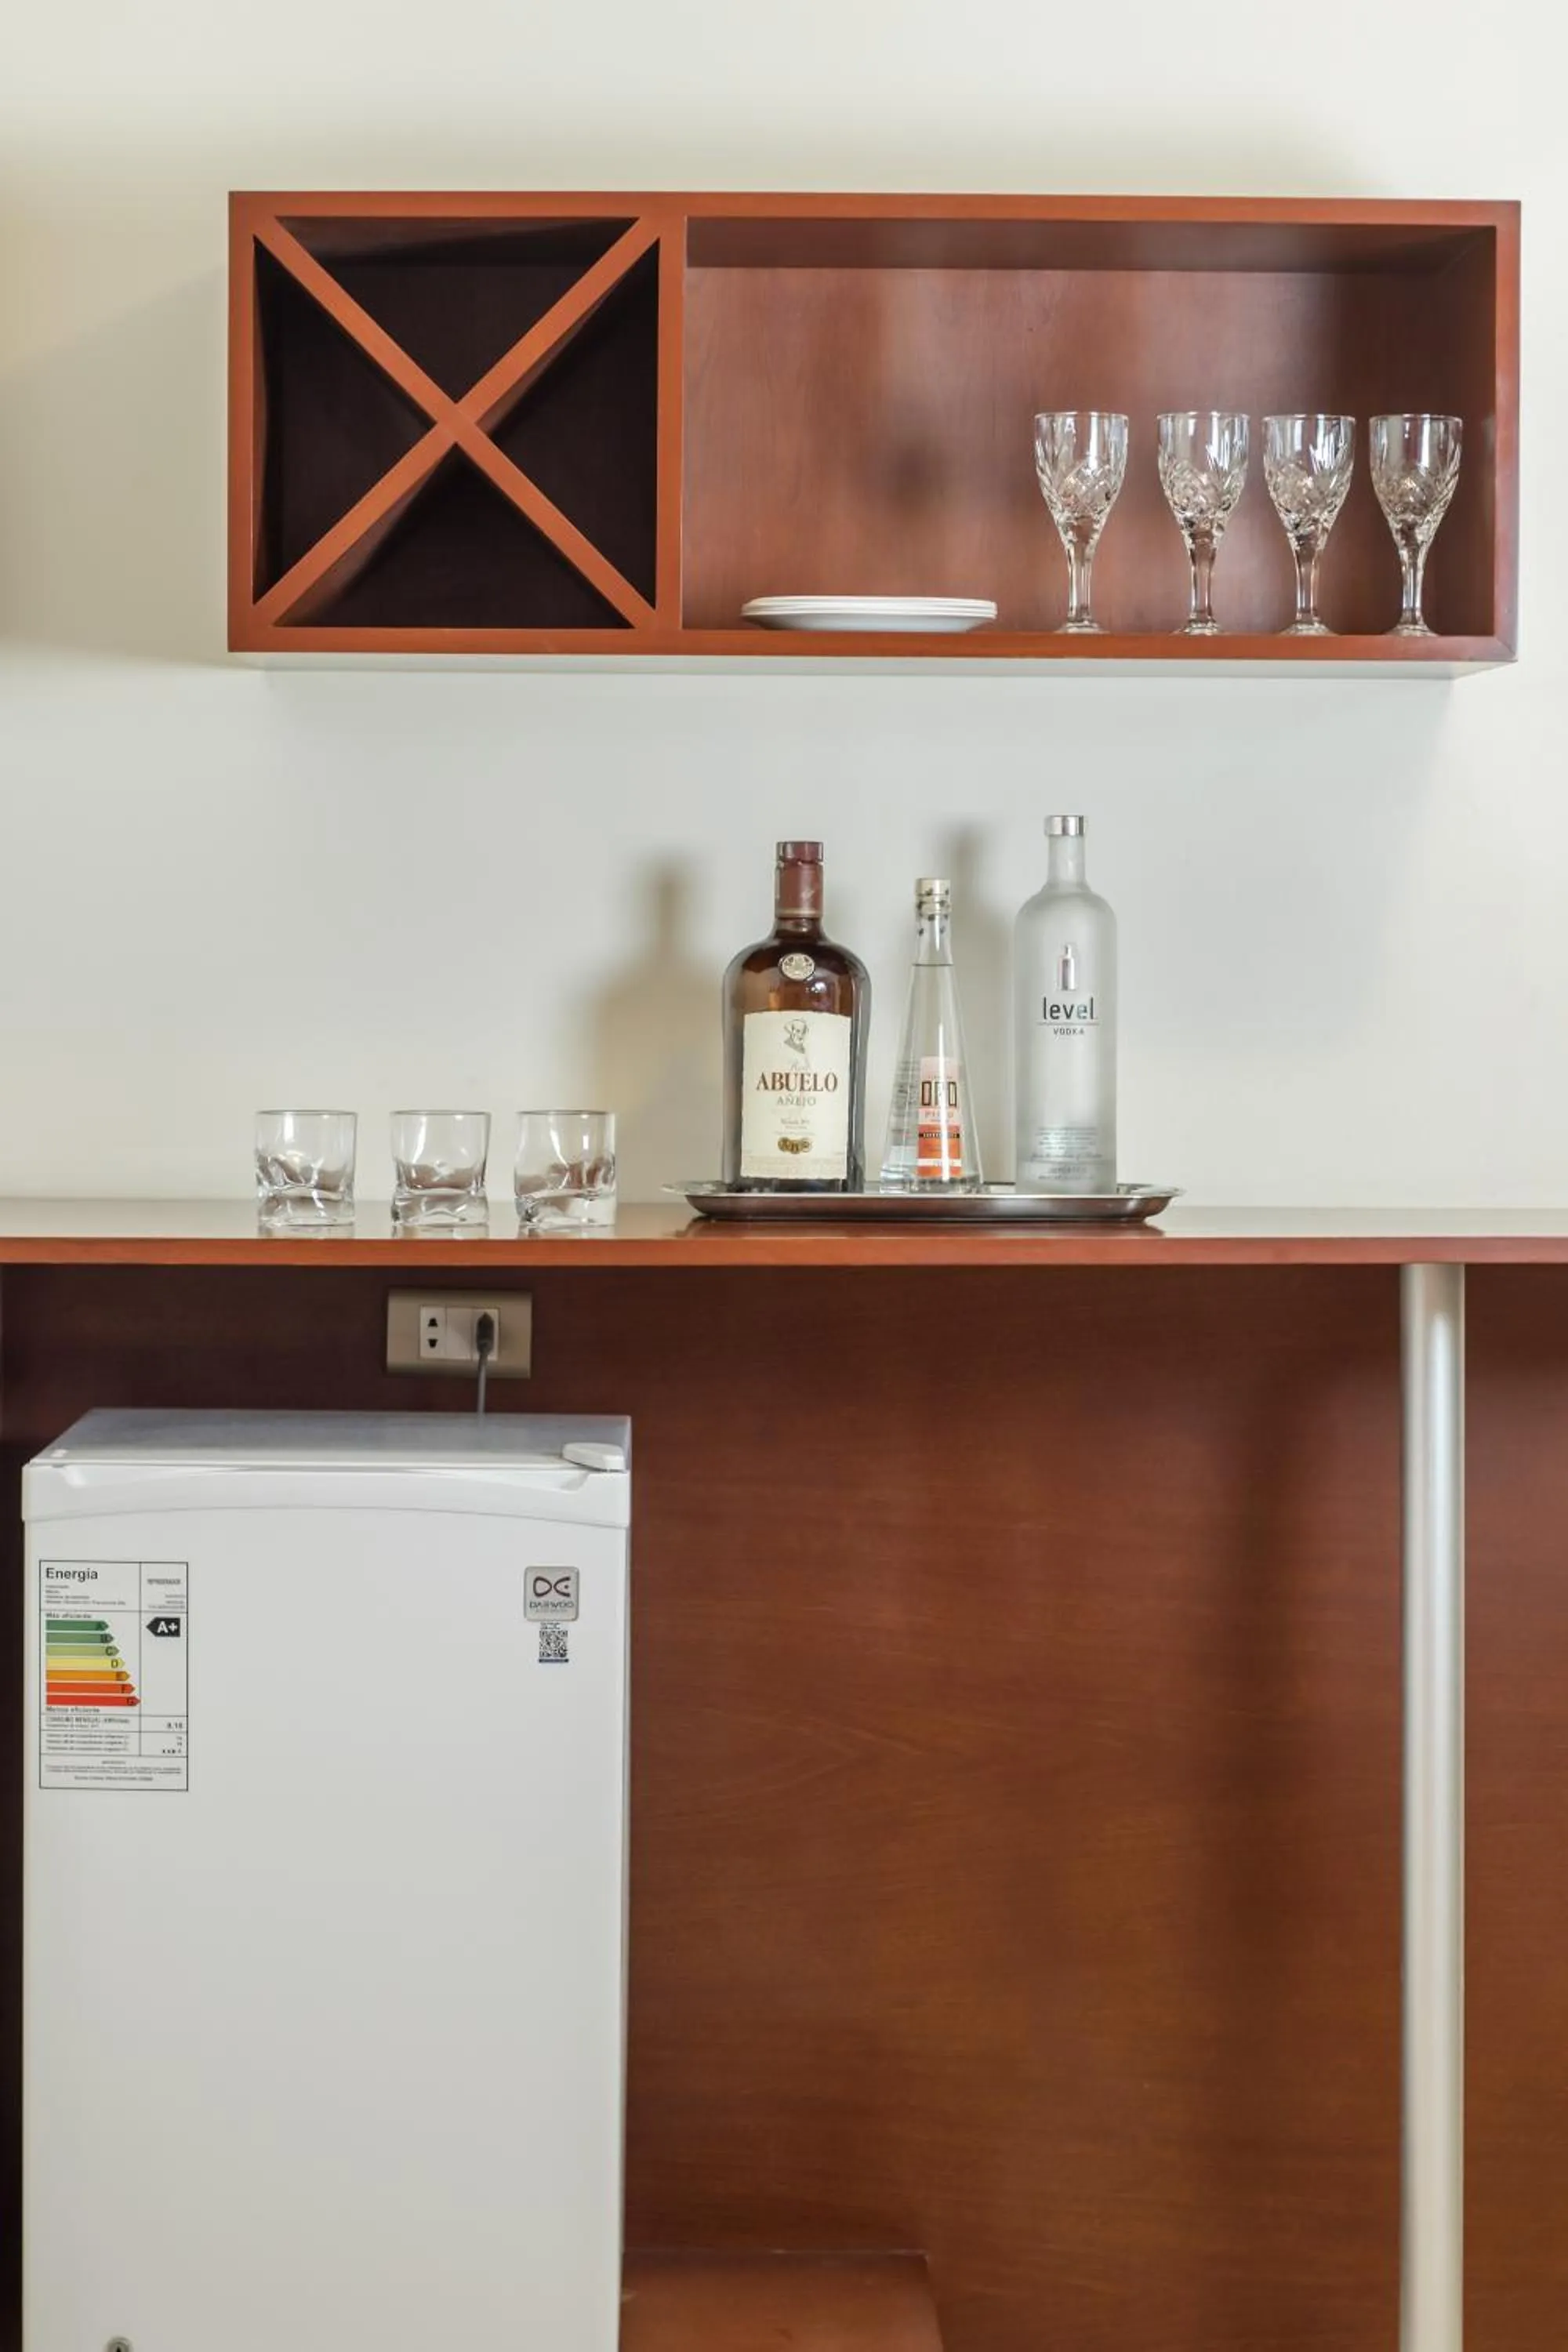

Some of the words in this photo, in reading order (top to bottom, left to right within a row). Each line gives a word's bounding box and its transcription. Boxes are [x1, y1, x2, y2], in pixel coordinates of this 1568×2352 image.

[1043, 996, 1094, 1020] level
[756, 1072, 838, 1092] ABUELO
[776, 1094, 817, 1107] AÑEJO
[158, 1621, 178, 1633] A+
[105, 1646, 114, 1657] C
[111, 1658, 118, 1668] D
